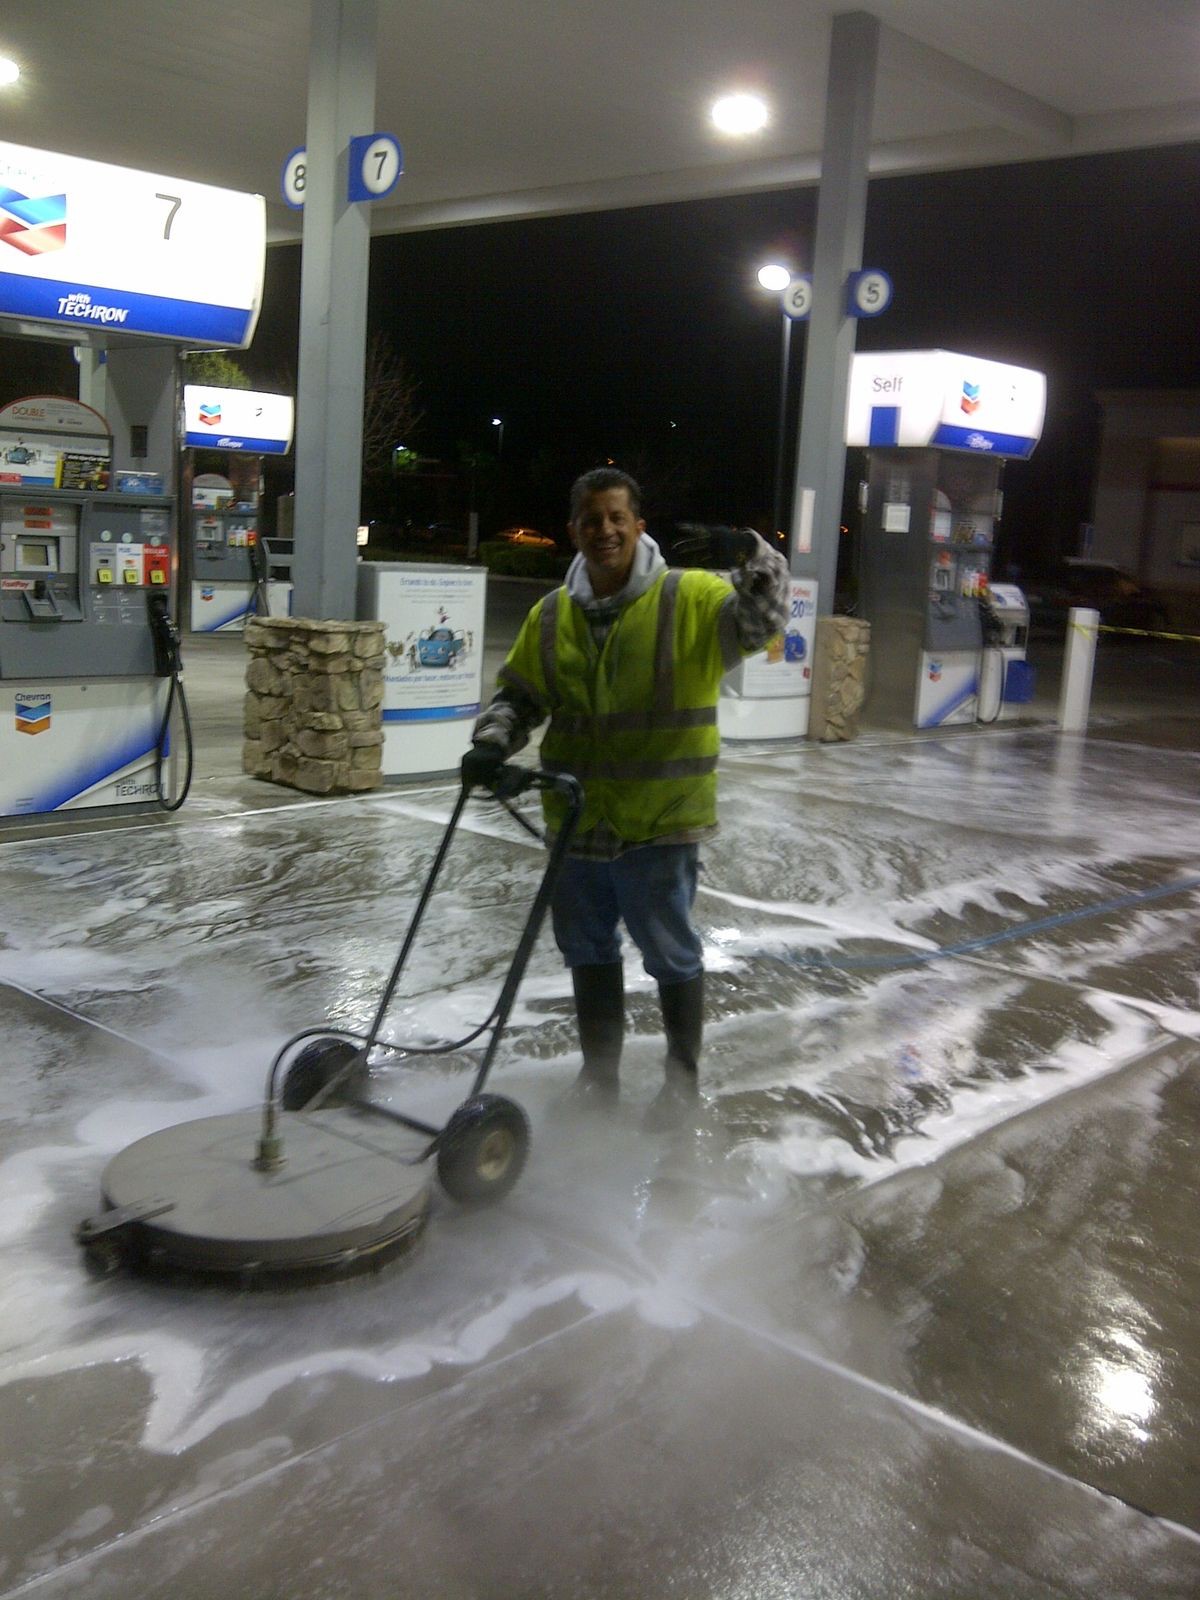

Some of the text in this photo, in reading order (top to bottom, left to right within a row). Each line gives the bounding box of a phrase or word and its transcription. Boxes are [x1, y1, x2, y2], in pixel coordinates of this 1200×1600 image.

[373, 151, 388, 181] 7
[294, 164, 306, 192] 8
[155, 192, 182, 240] 7
[68, 292, 91, 304] with
[792, 287, 805, 308] 6
[867, 283, 880, 304] 5
[57, 297, 129, 323] TECHRON
[872, 377, 904, 393] Self
[791, 600, 805, 618] 20
[15, 693, 51, 701] Chevron
